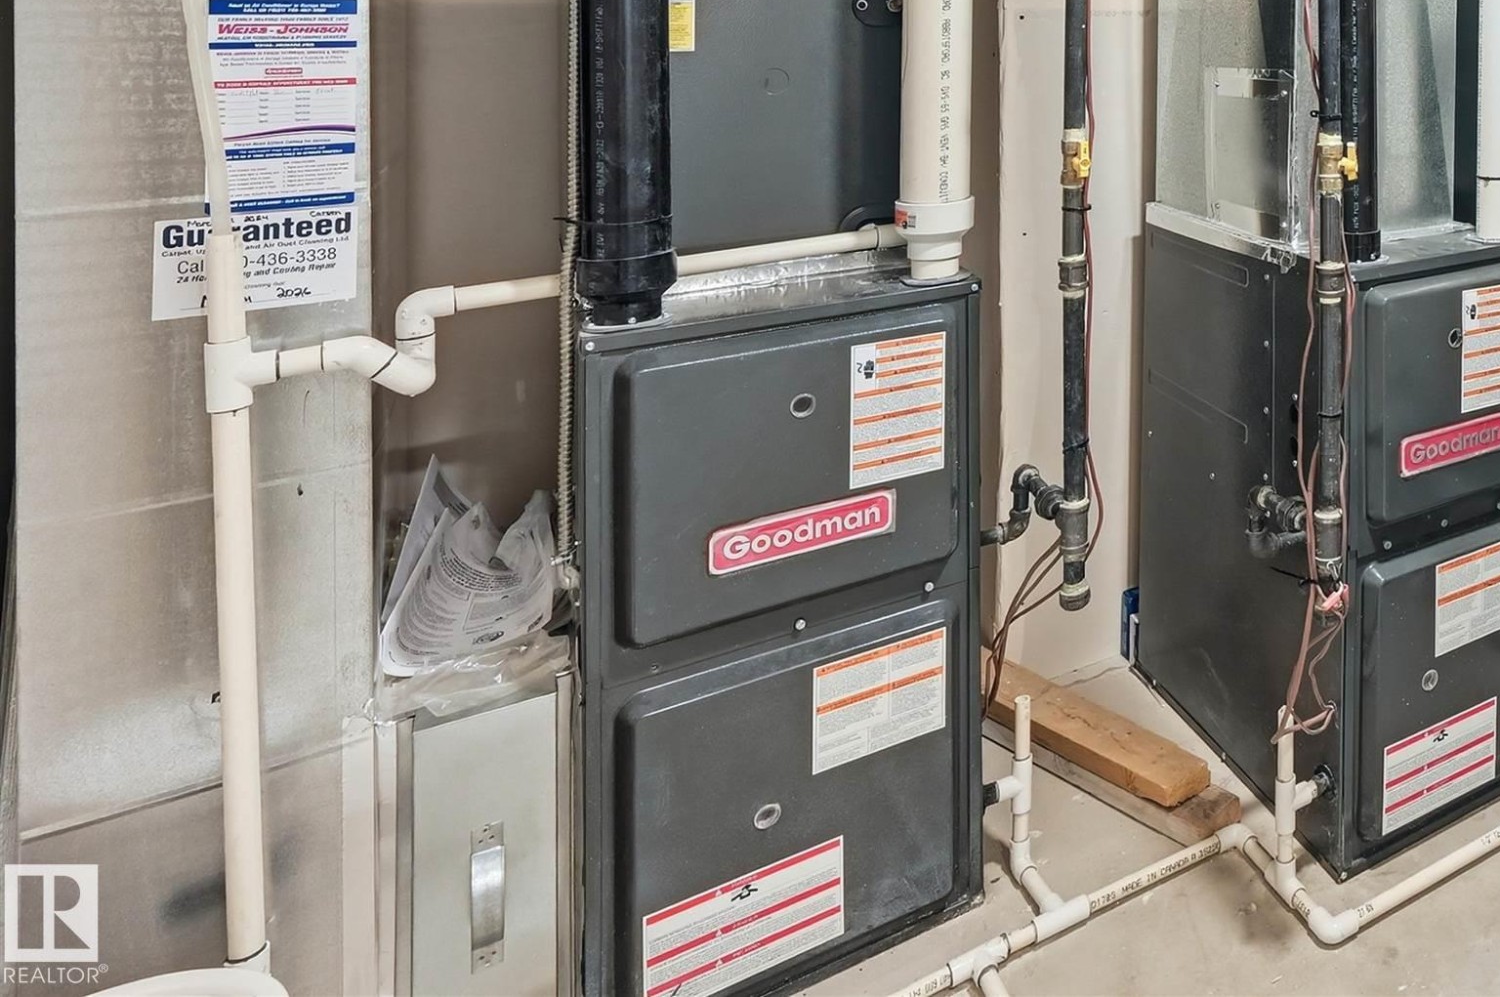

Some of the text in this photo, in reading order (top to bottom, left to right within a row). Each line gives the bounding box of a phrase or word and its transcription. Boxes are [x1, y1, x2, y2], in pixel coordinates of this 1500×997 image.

[722, 503, 882, 560] Goodman
[1120, 877, 1145, 894] MADE
[1145, 870, 1158, 882] IN
[1158, 855, 1189, 876] CANADA
